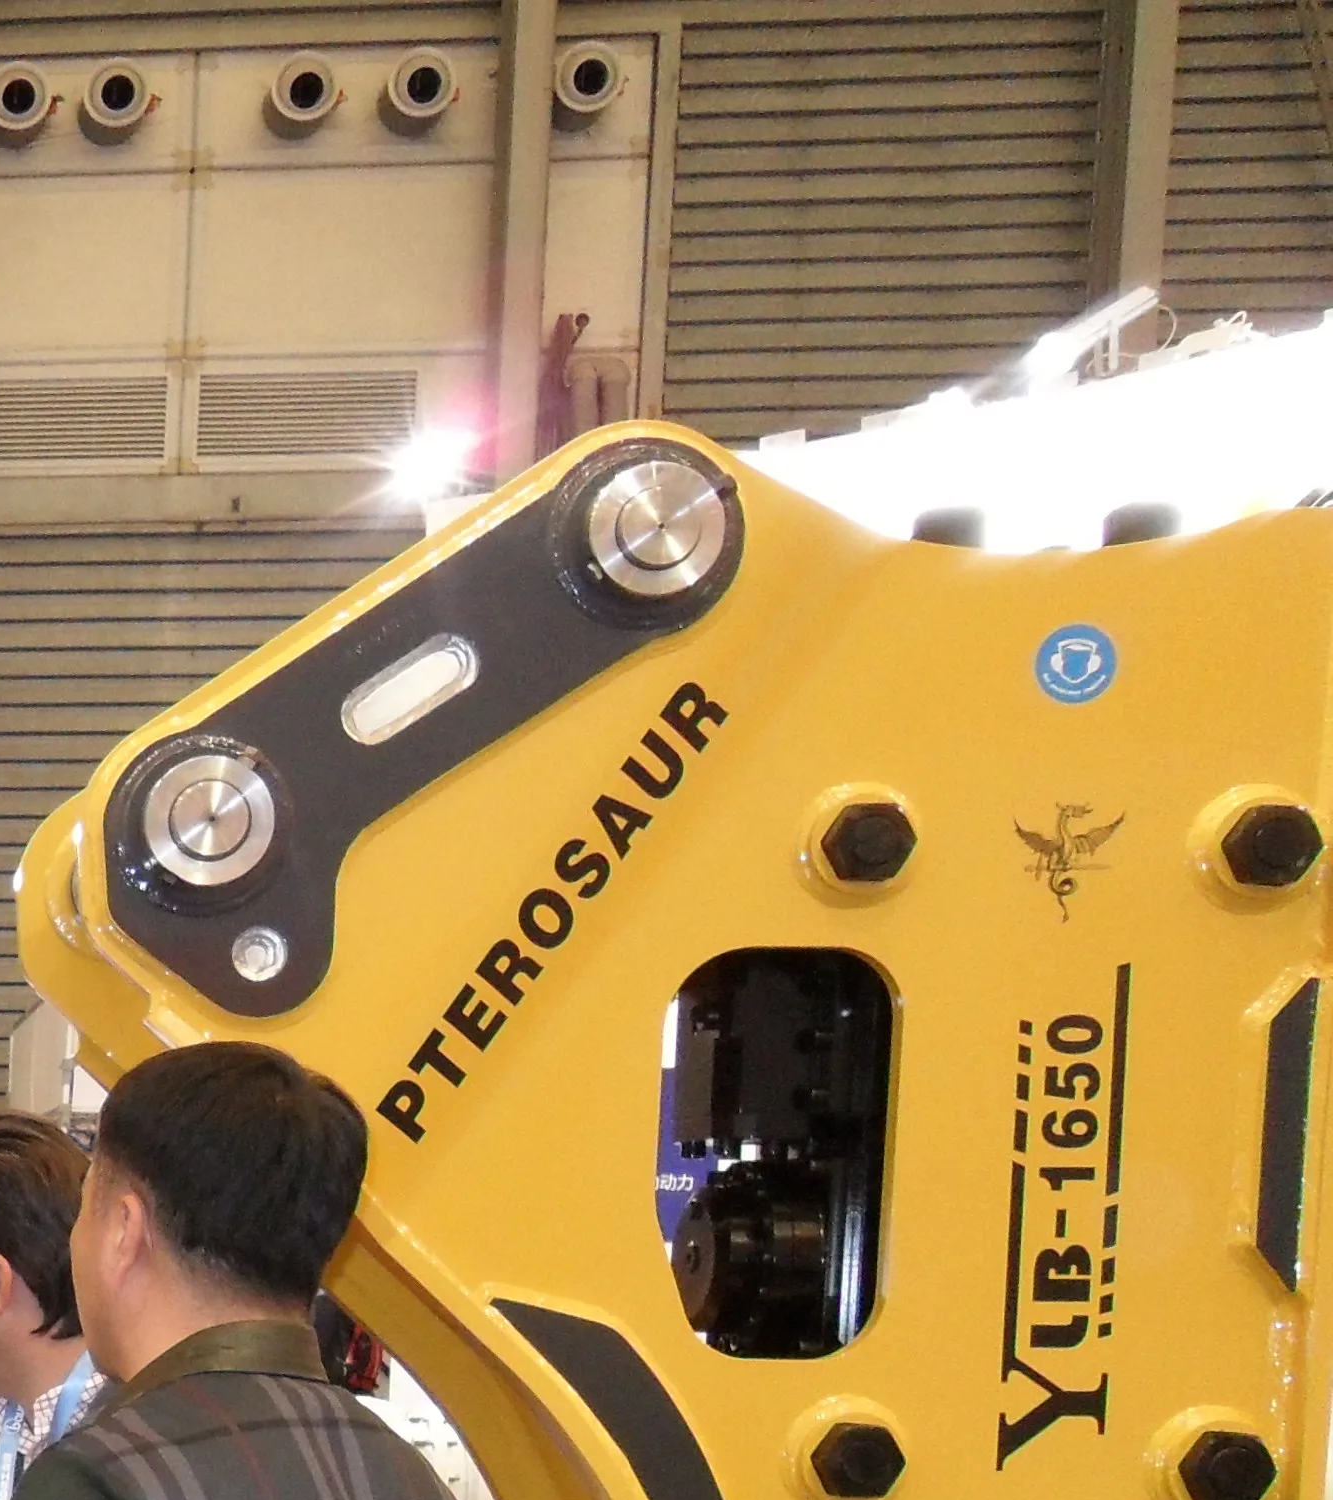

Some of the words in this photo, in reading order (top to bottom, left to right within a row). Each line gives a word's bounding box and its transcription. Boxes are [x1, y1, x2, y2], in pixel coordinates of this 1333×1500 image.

[375, 681, 729, 1144] PTEROSAUR
[655, 1173, 694, 1192] 动力
[996, 1013, 1109, 1472] YLB-1650
